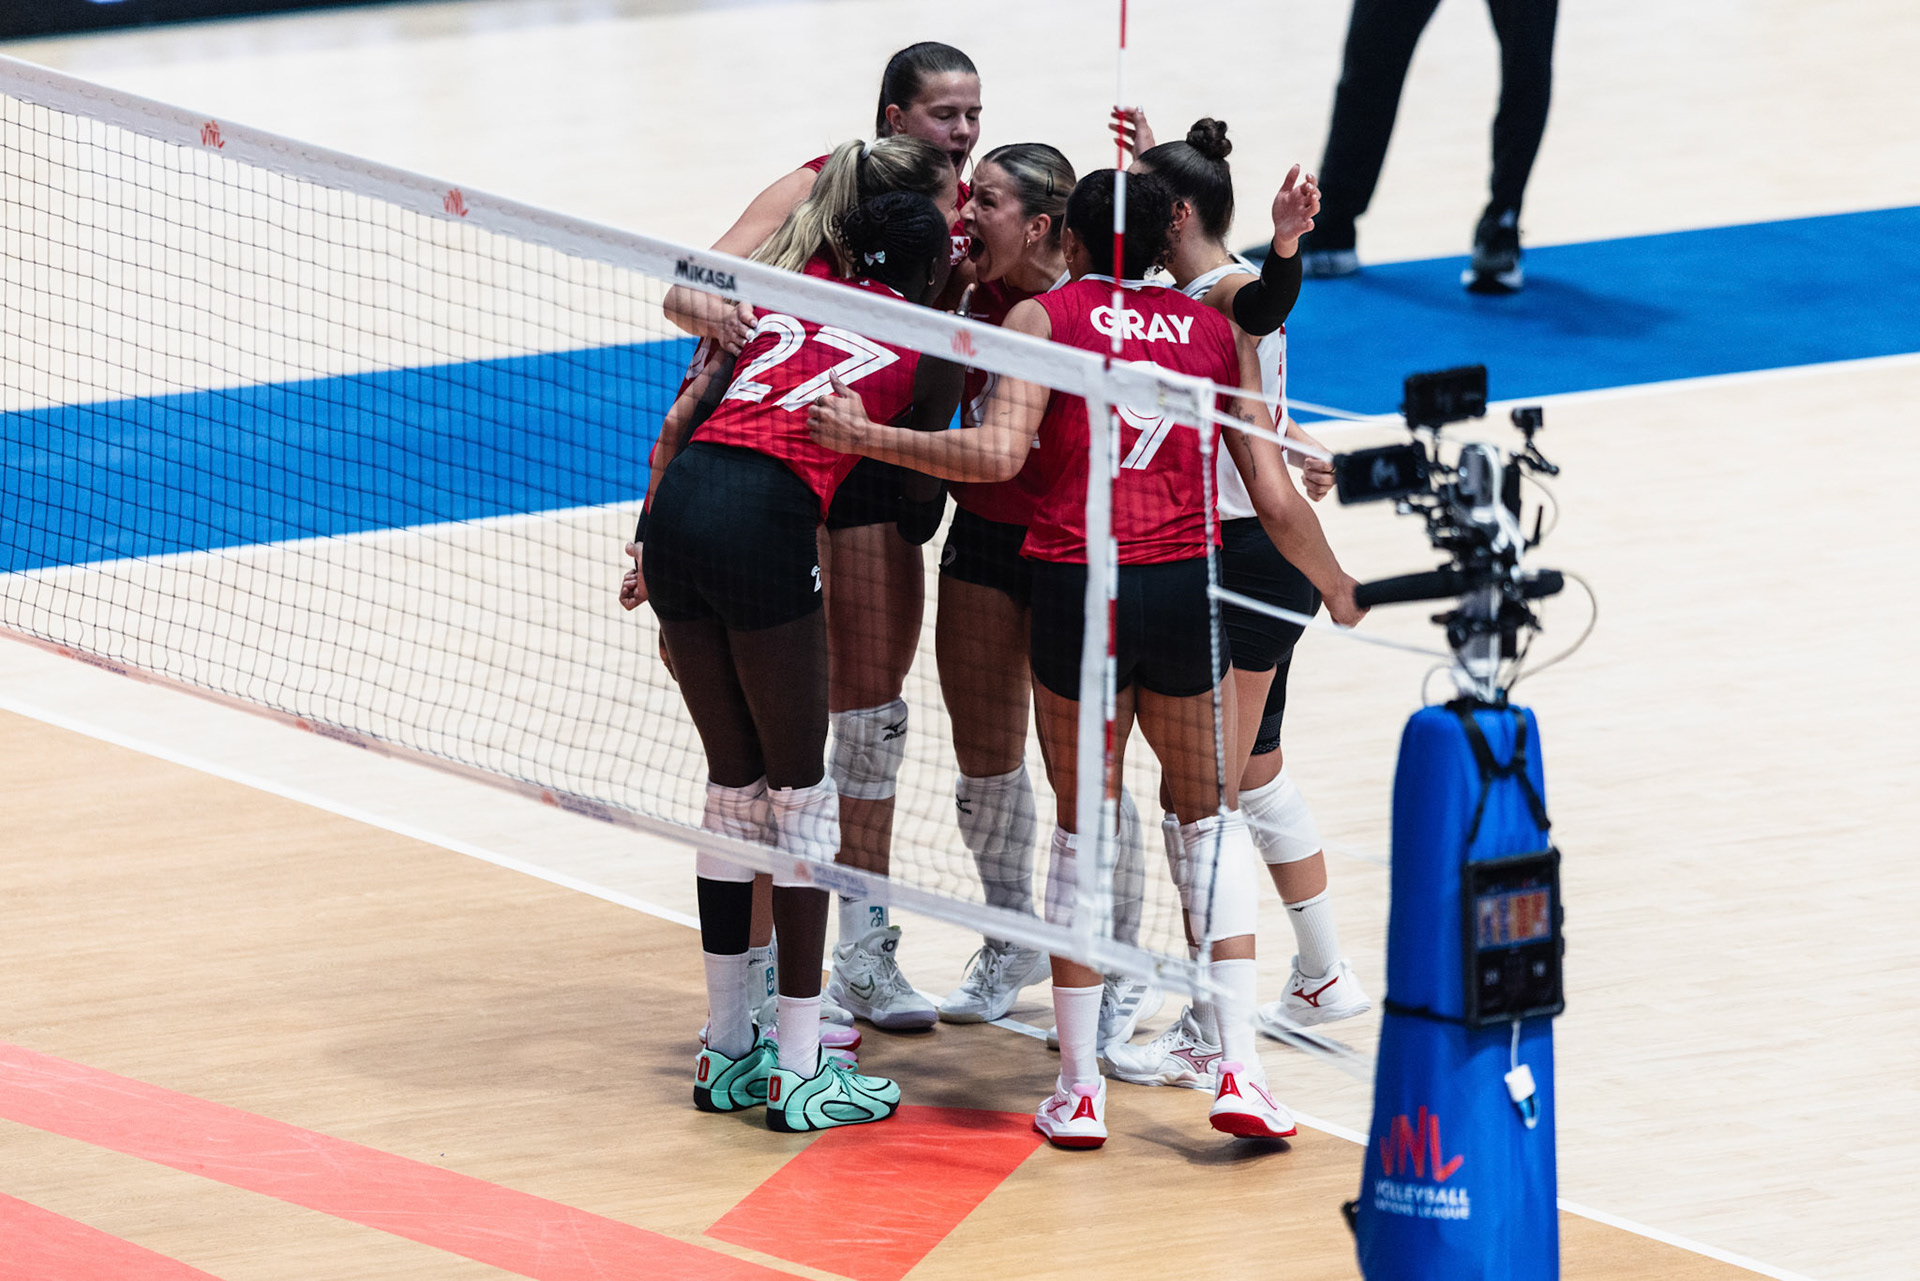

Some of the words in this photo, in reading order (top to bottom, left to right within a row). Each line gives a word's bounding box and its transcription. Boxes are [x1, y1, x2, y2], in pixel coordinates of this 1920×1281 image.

[720, 313, 900, 412] 27
[1090, 305, 1194, 344] GRAY
[1379, 1105, 1464, 1183] VNL
